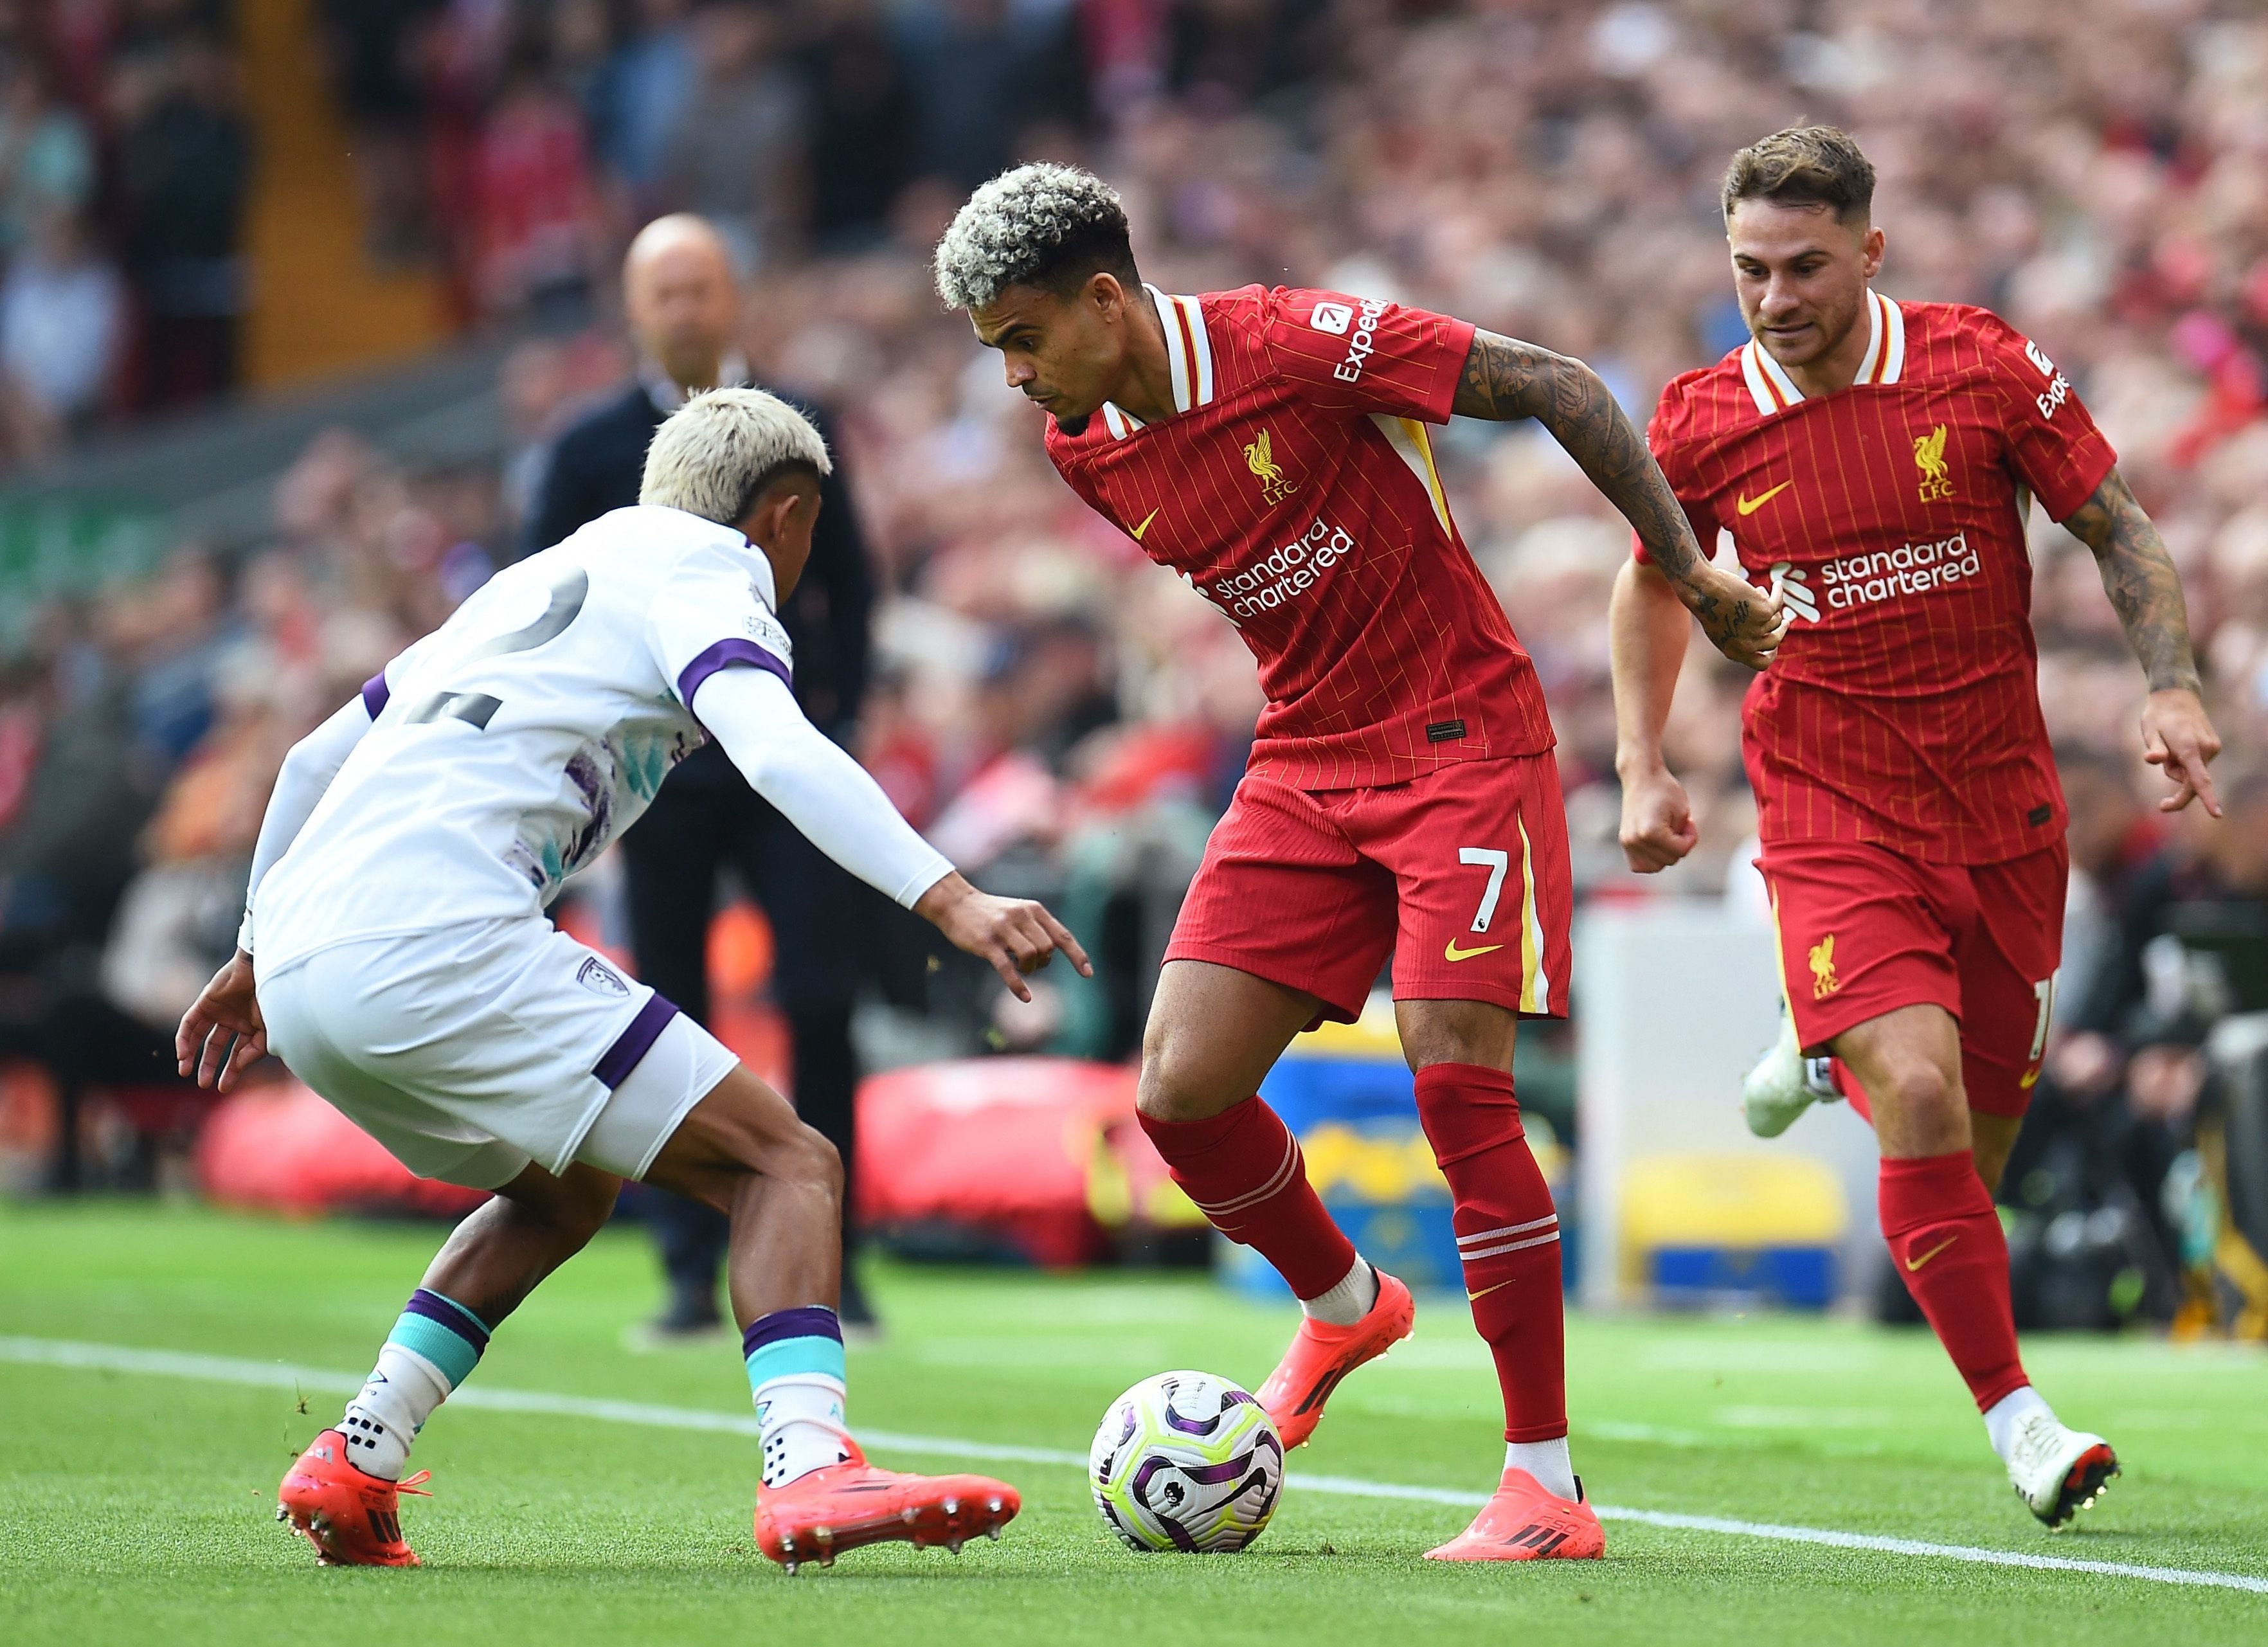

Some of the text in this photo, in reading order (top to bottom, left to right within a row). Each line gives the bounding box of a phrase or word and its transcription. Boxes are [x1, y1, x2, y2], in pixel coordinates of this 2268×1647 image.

[1263, 480, 1300, 506] L.F.C.
[1216, 516, 1329, 599] standard
[1234, 526, 1354, 617] chartered
[1821, 530, 1967, 584] standard
[1828, 549, 1980, 608] chartered
[1459, 847, 1508, 932] 7
